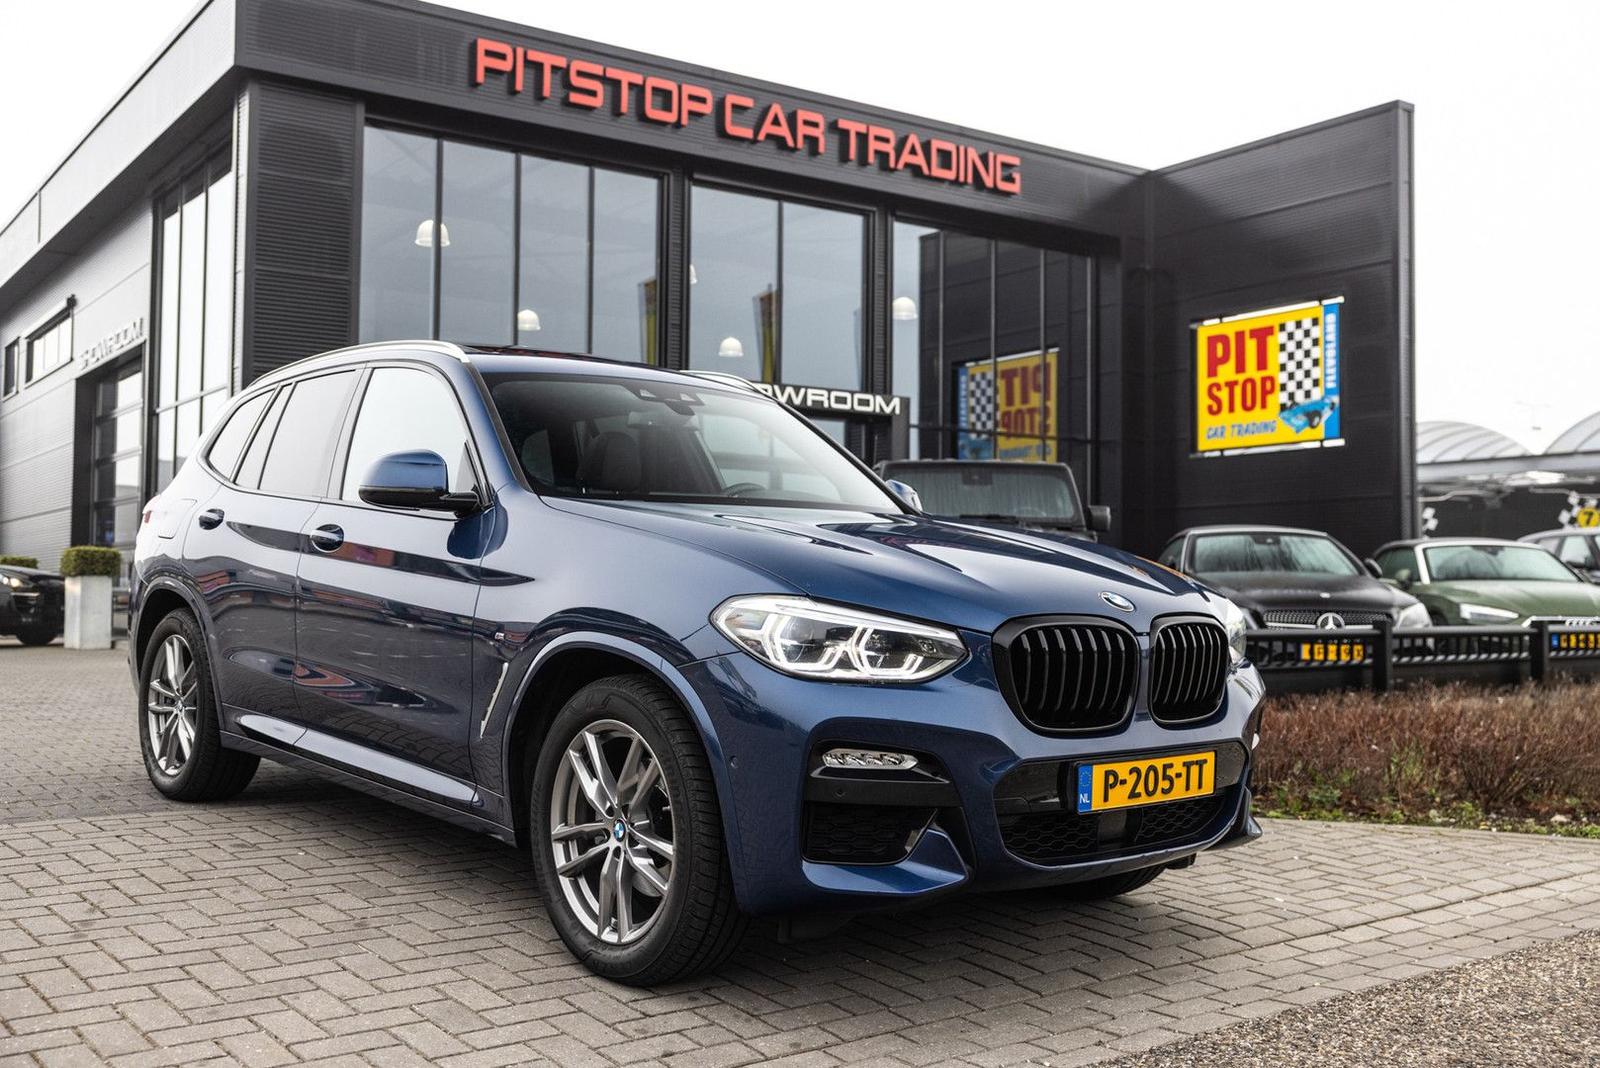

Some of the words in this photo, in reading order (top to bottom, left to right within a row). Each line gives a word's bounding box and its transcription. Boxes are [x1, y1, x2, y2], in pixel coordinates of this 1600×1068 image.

[475, 37, 714, 128] PITSTOP
[723, 94, 826, 154] CAR
[837, 118, 1021, 194] TRADING
[1206, 325, 1275, 379] PIT
[1206, 375, 1276, 416] STOP
[1206, 425, 1226, 440] CAR
[1230, 420, 1277, 438] TRADING
[1583, 511, 1595, 526] 7
[1079, 793, 1091, 804] NL
[1102, 758, 1208, 803] P-205-TT
